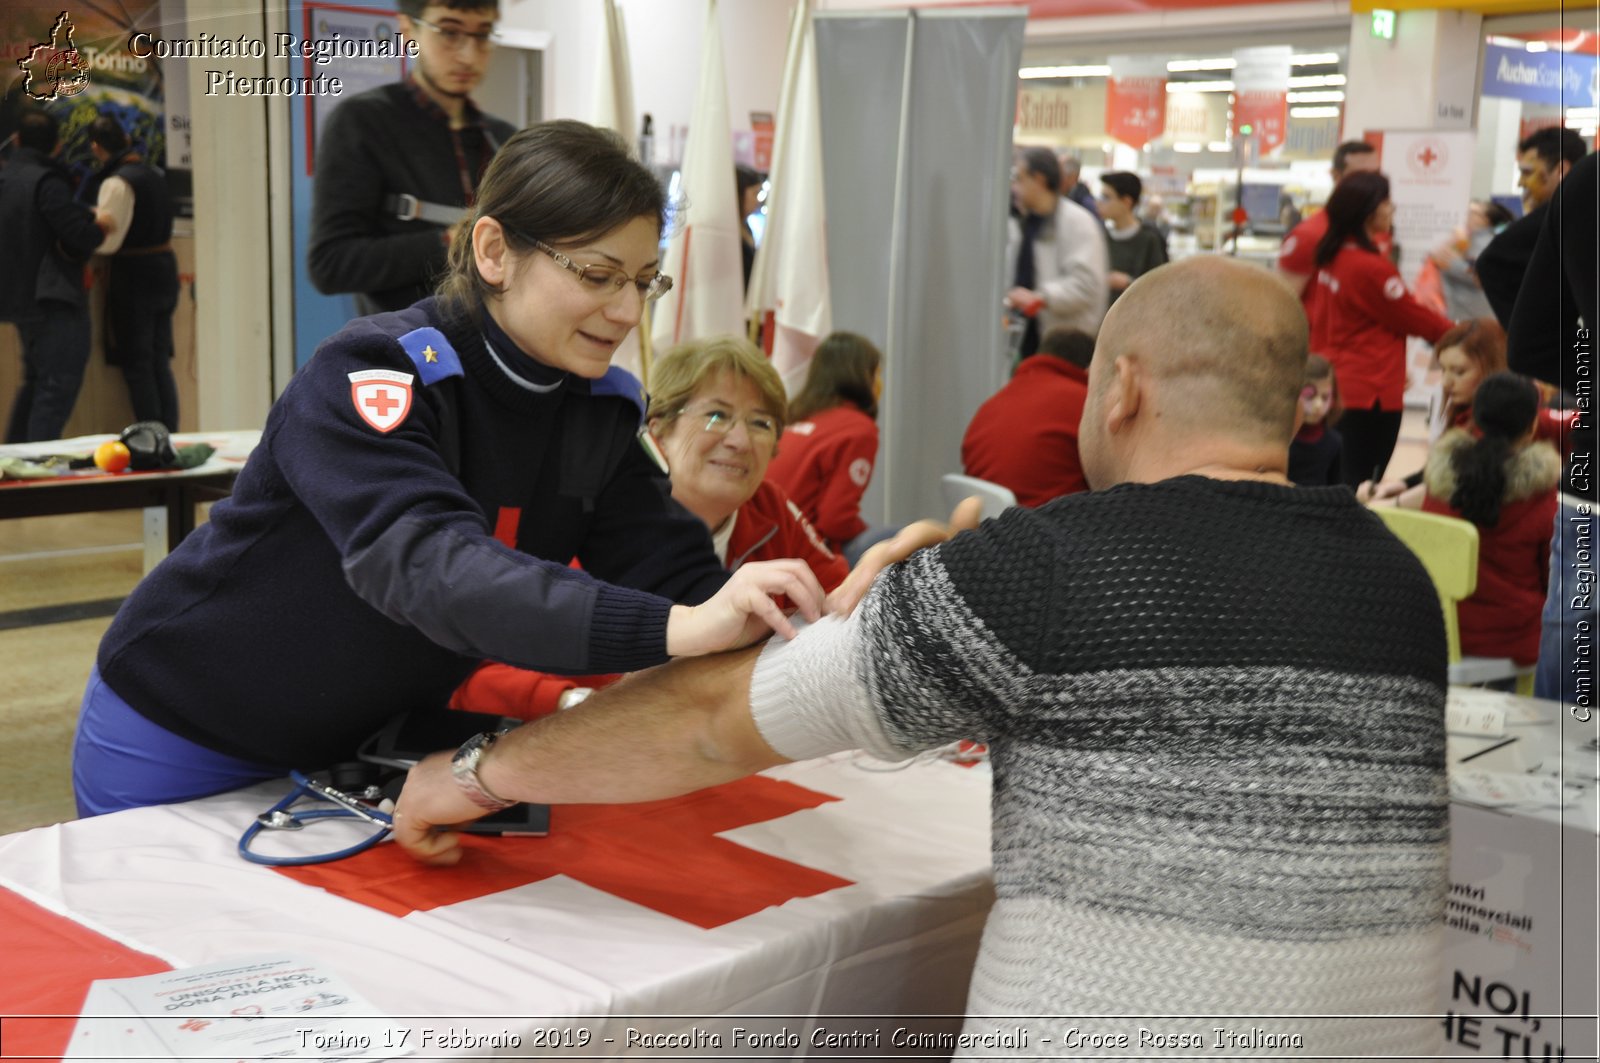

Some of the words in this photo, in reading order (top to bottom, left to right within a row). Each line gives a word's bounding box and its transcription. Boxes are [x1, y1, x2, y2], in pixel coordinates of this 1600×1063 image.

[1448, 882, 1486, 901] ntri
[164, 994, 227, 1012] DONA
[230, 982, 297, 1000] ANCHE
[169, 982, 252, 1002] UNISCITI
[257, 979, 271, 988] A
[1452, 968, 1541, 1033] NOI,
